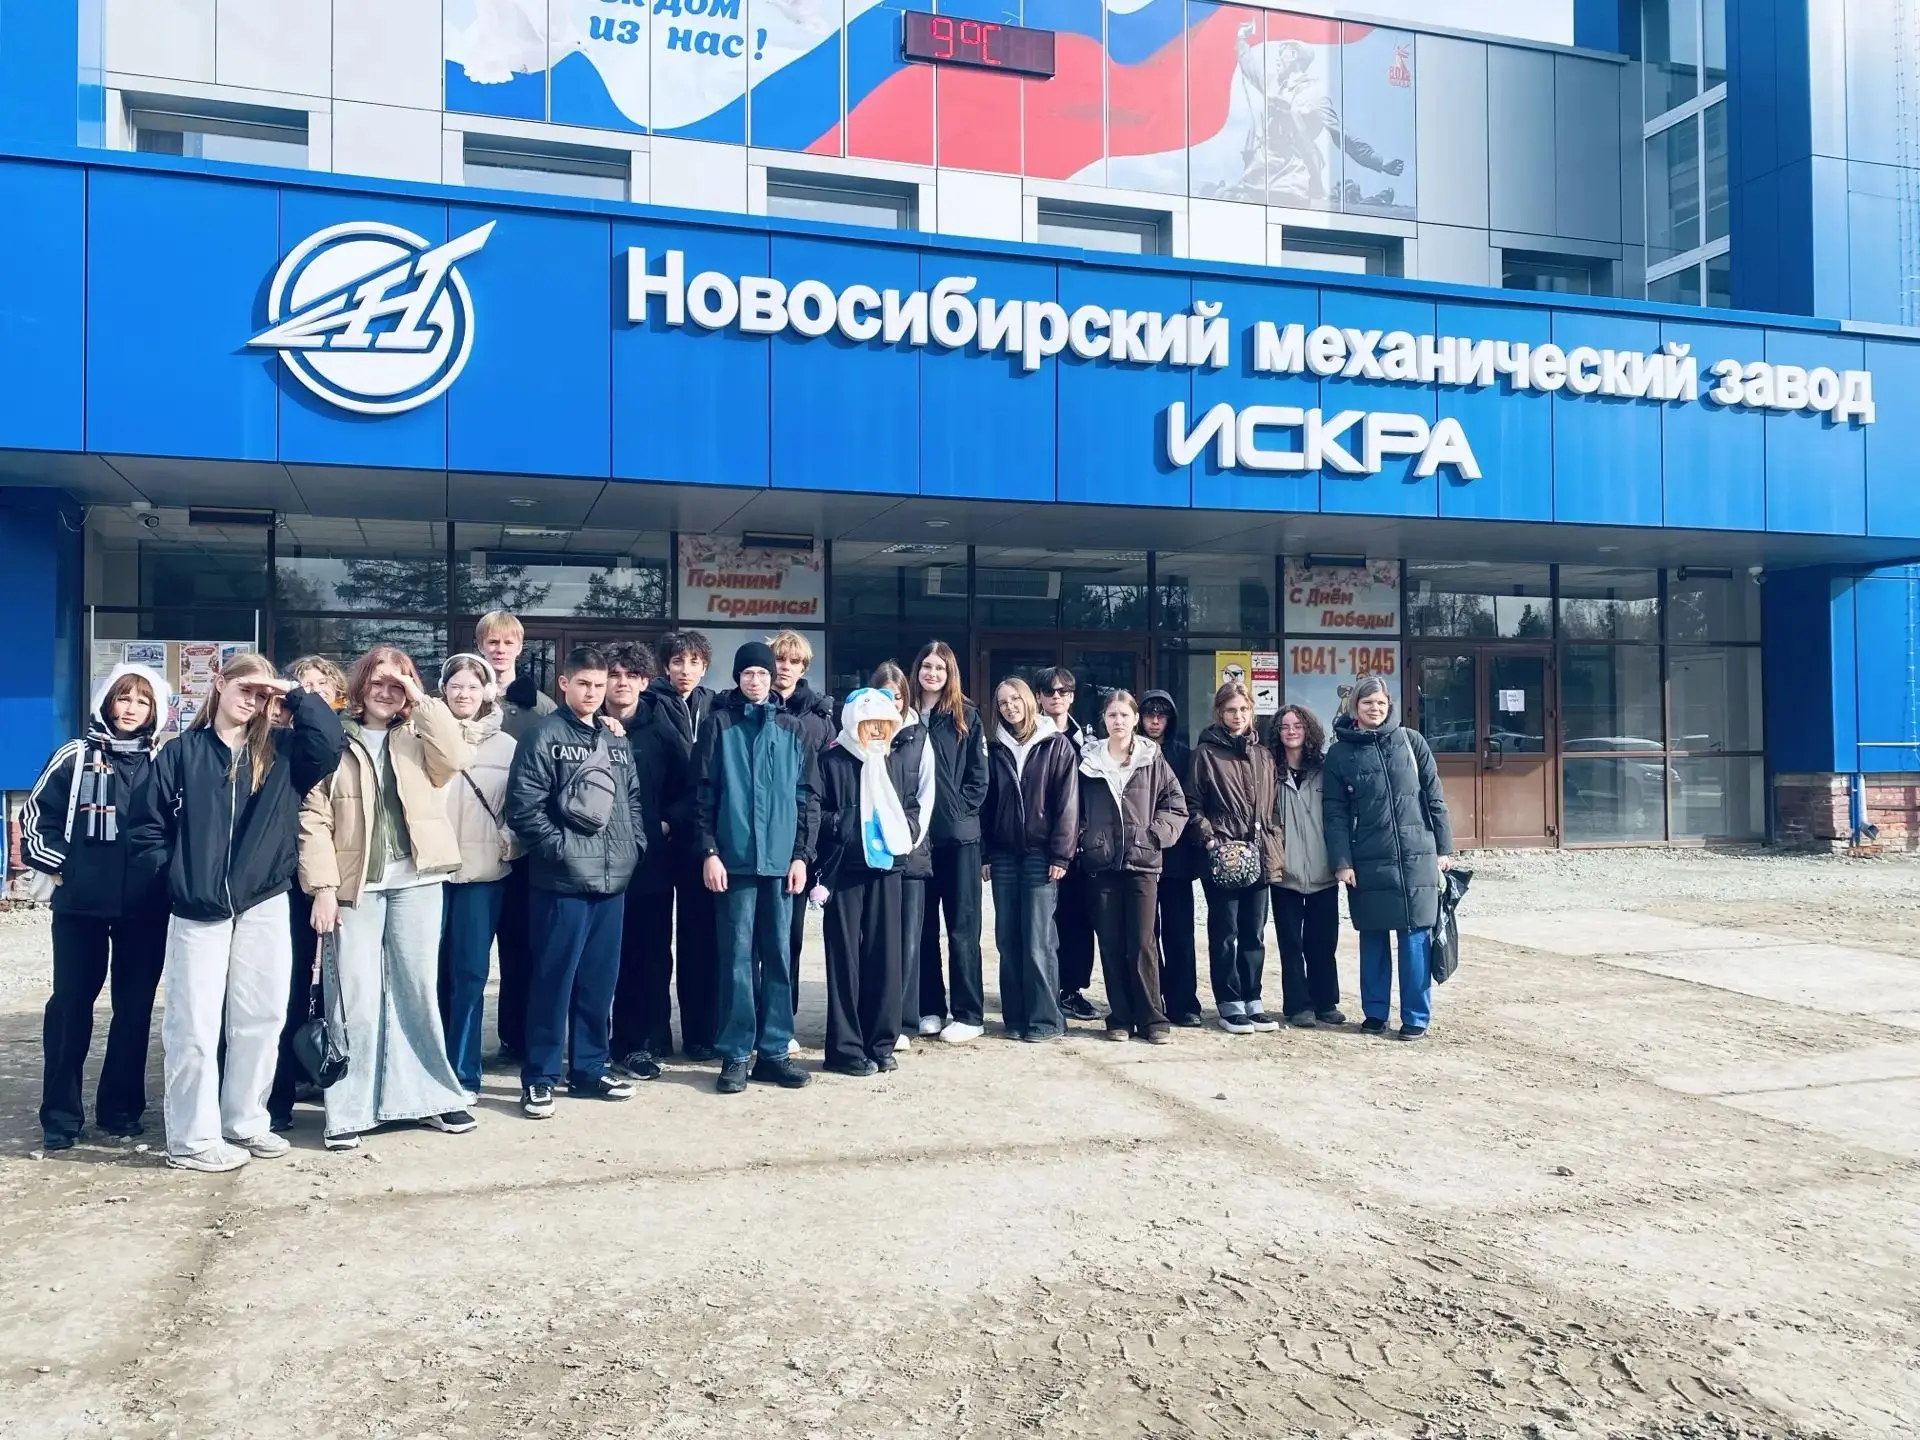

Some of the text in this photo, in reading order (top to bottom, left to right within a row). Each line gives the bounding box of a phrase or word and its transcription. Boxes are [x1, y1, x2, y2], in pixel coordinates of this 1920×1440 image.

[589, 15, 641, 45] из
[627, 246, 1876, 427] Новосибирский механический завод
[1166, 400, 1482, 481] ИСКРА
[686, 568, 783, 591] Помним!
[707, 594, 818, 618] Гордимся!
[1289, 587, 1354, 607] С Днём
[1320, 610, 1395, 630] Победы!
